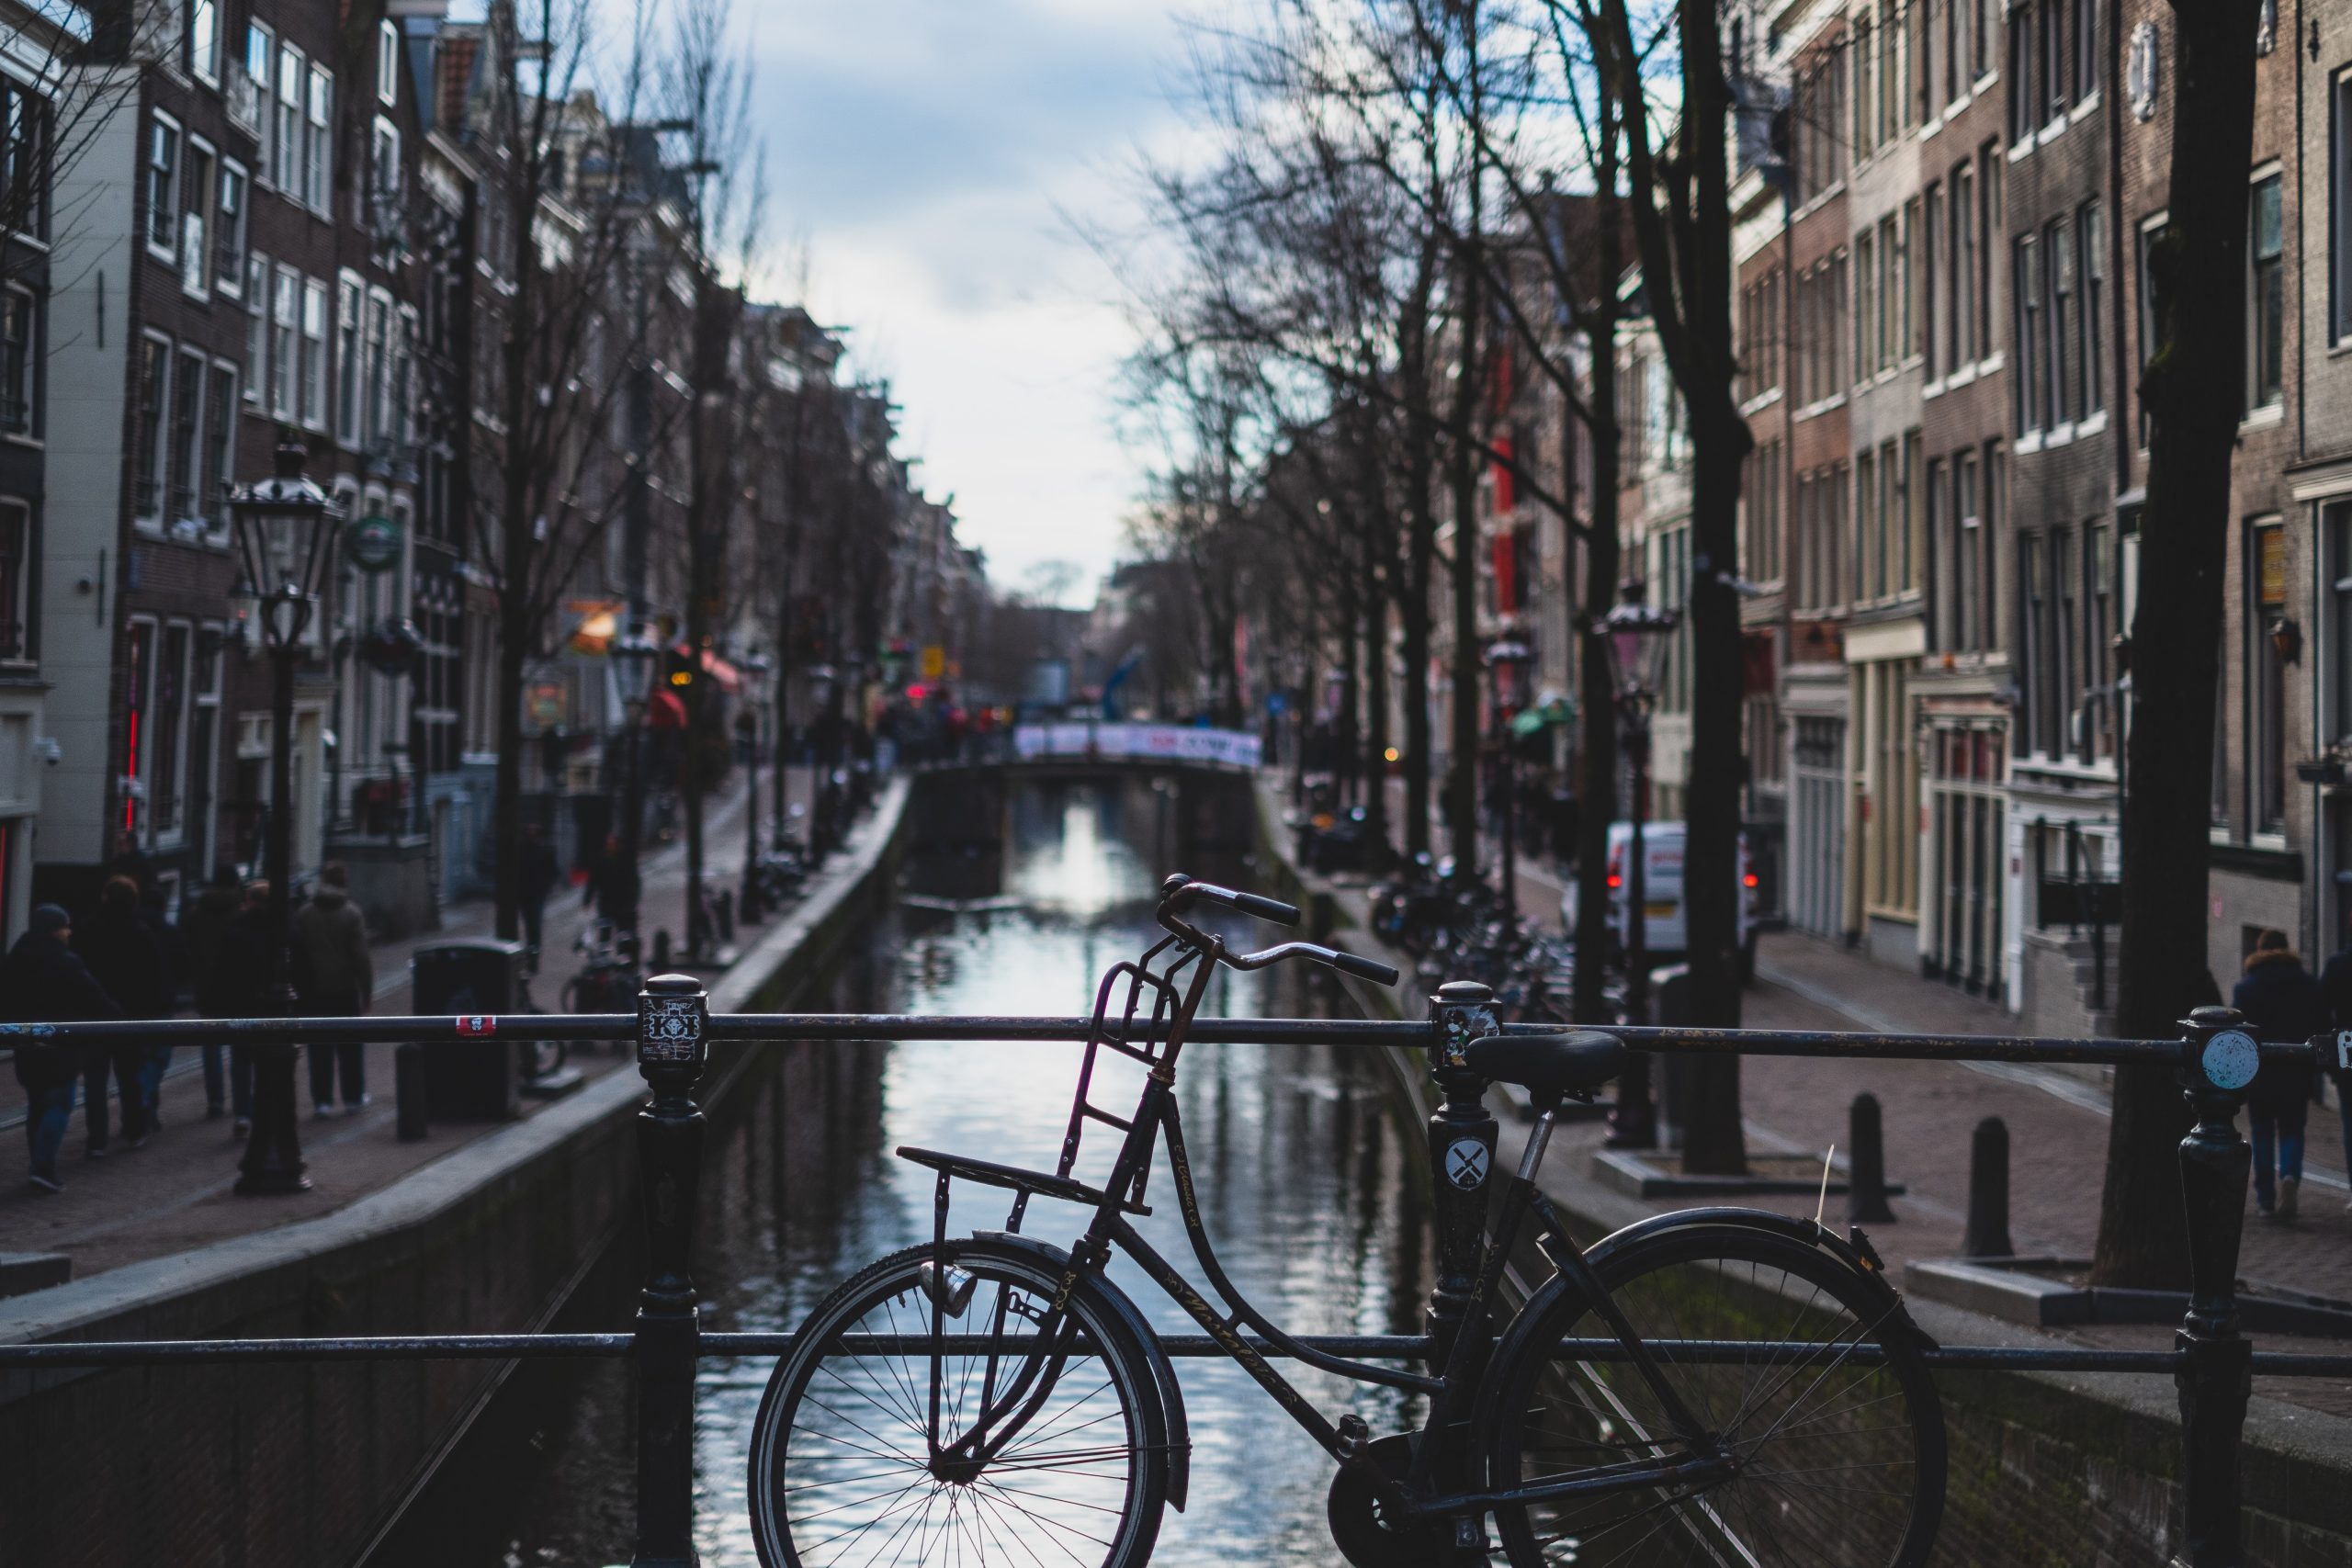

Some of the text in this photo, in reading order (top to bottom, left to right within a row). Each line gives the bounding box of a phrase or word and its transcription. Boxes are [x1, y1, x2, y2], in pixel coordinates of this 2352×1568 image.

[1177, 1165, 1193, 1207] Classic
[842, 1265, 883, 1294] CLASSIC
[884, 1250, 919, 1266] TREND
